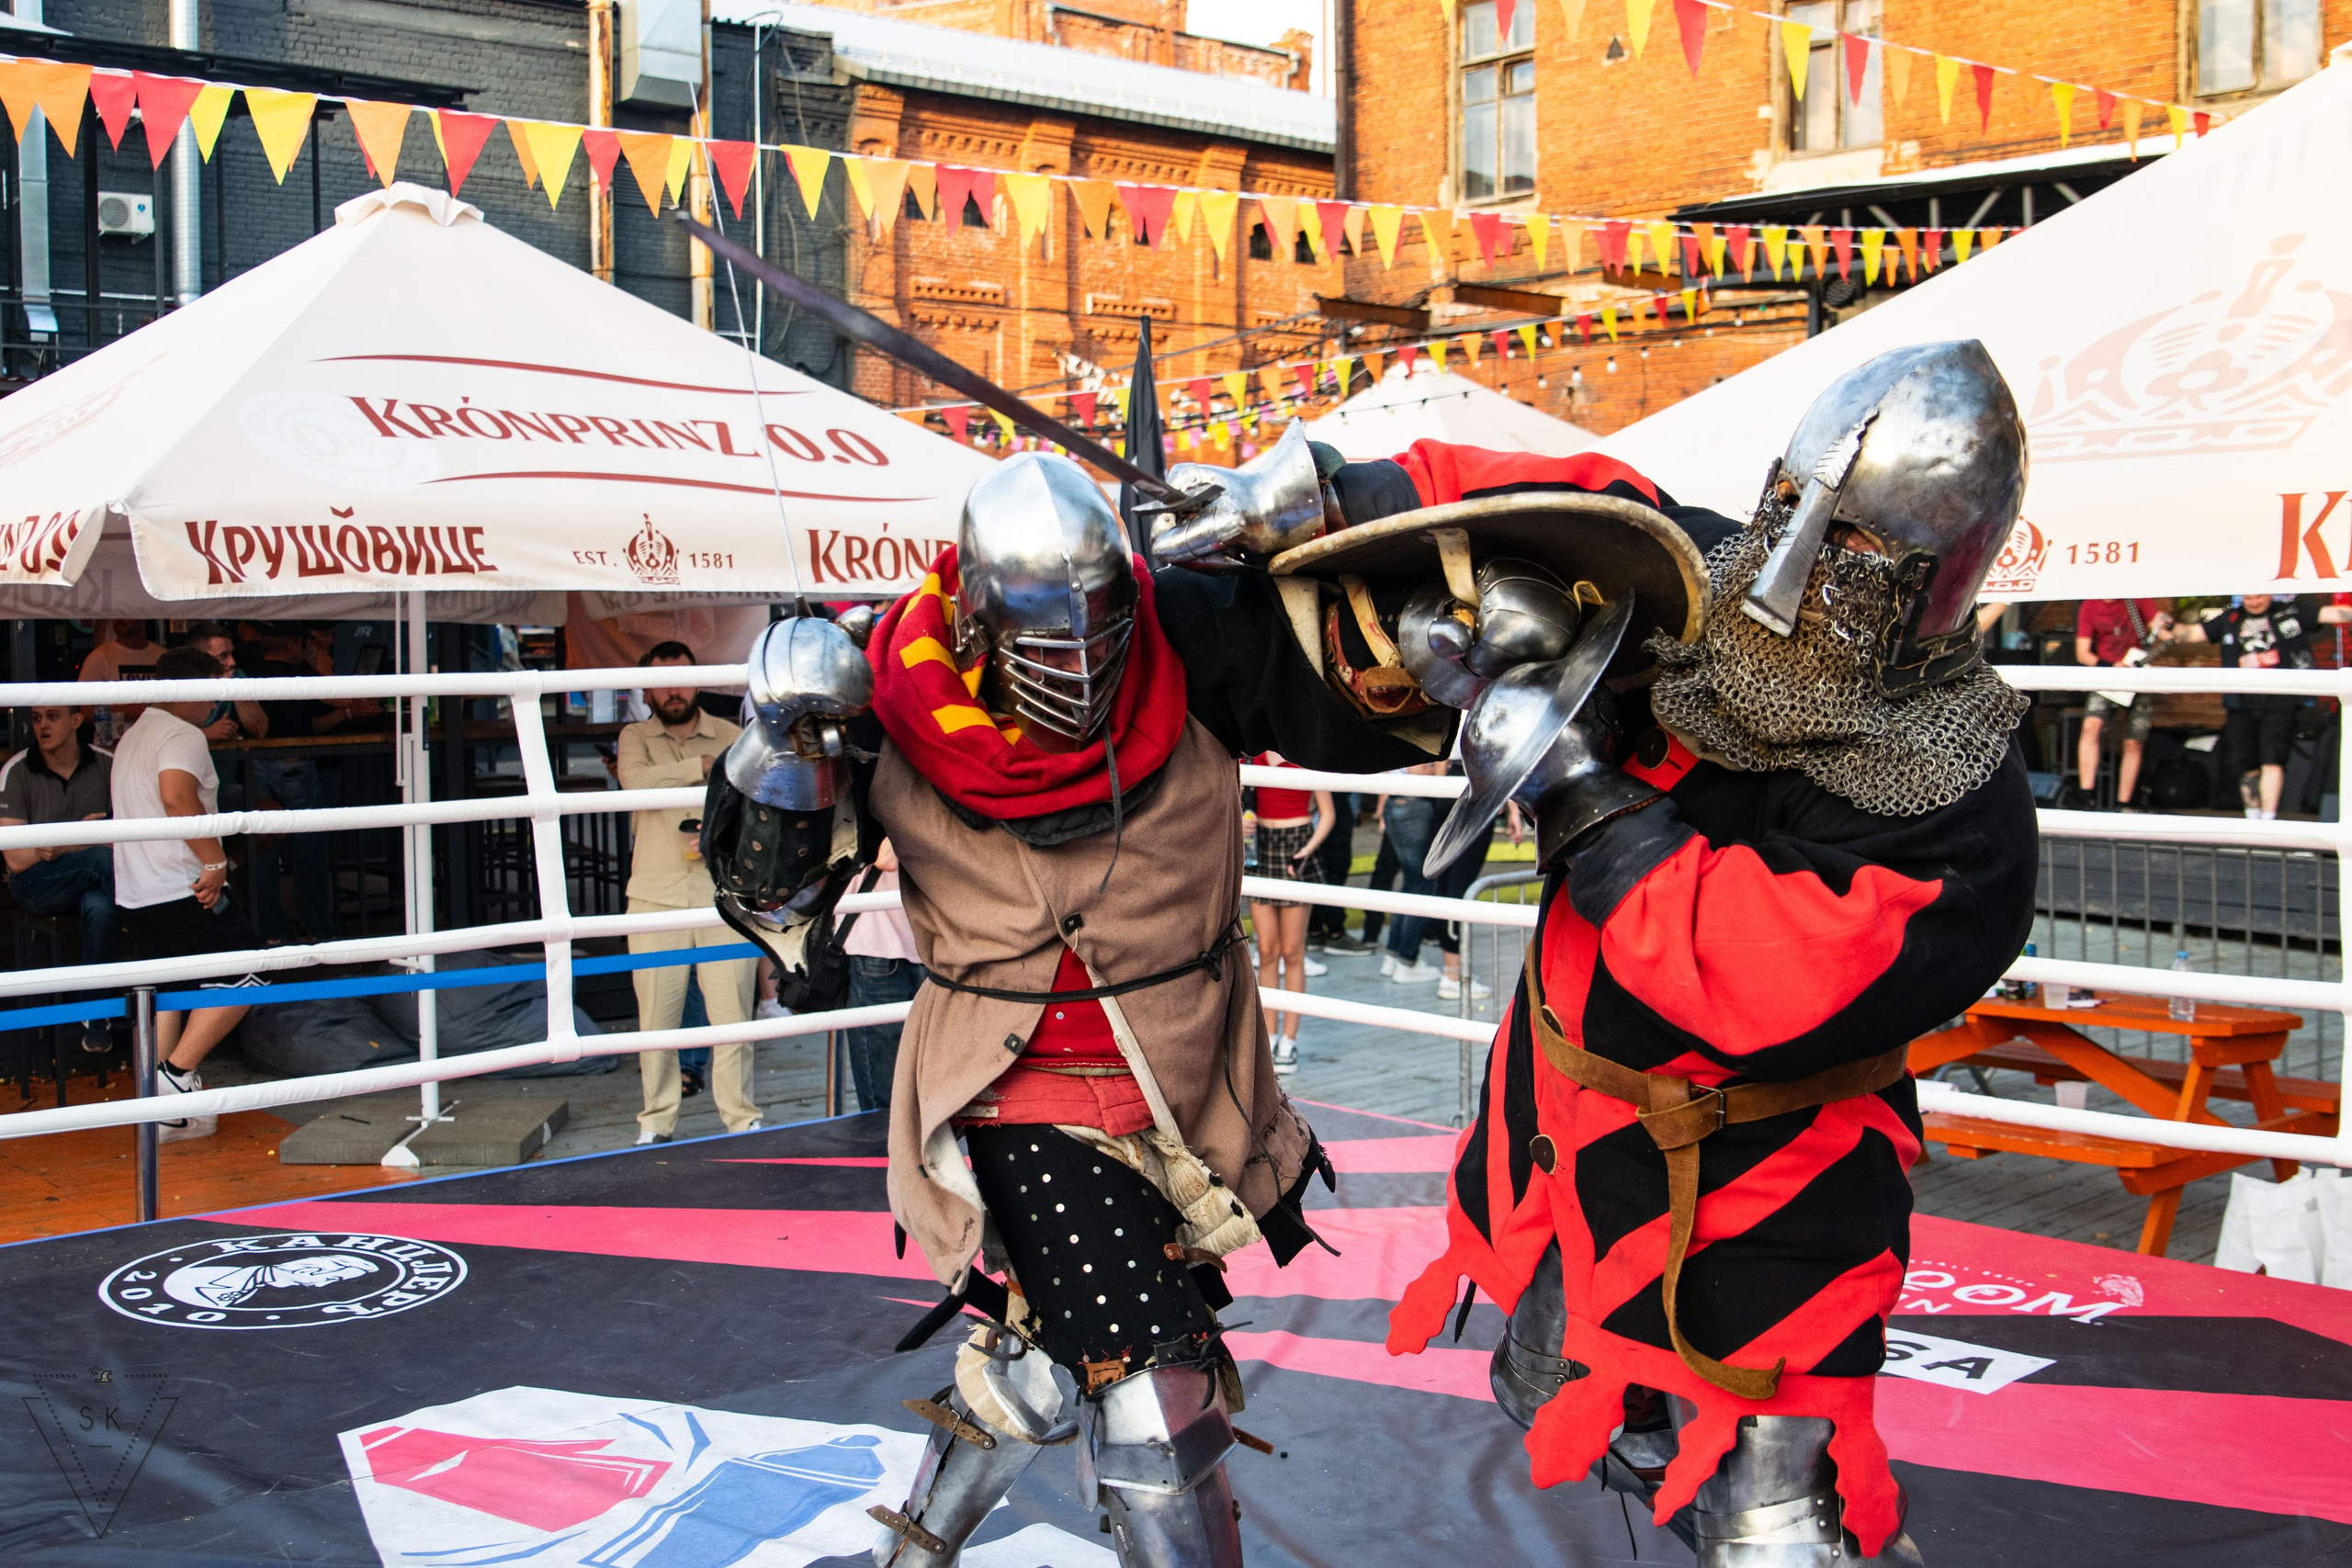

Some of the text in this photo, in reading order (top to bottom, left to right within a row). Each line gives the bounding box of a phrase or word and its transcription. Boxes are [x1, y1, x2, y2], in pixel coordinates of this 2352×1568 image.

[346, 397, 889, 467] KRÓNPRINZ 0.0
[572, 550, 734, 570] EST. 1581
[2066, 541, 2140, 566] 1581
[2269, 491, 2352, 581] K
[120, 1269, 228, 1323] 2010
[1903, 1270, 2128, 1324] OOM
